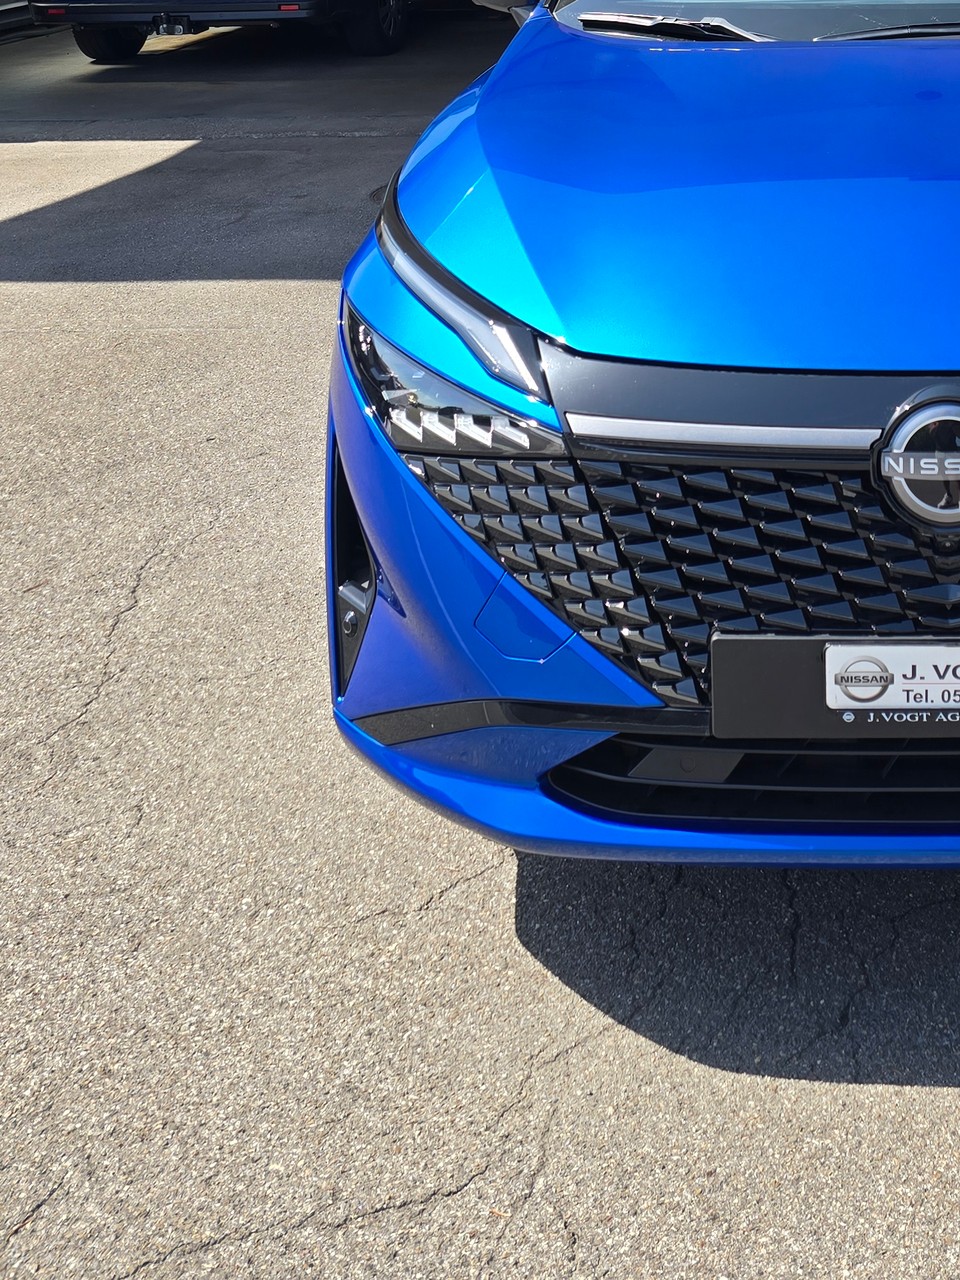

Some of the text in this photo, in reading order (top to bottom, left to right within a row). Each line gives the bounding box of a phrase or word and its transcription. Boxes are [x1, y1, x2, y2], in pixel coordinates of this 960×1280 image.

[902, 664, 925, 680] J.
[840, 674, 889, 684] NISSAN
[902, 689, 934, 704] Tel.
[935, 711, 960, 722] AG
